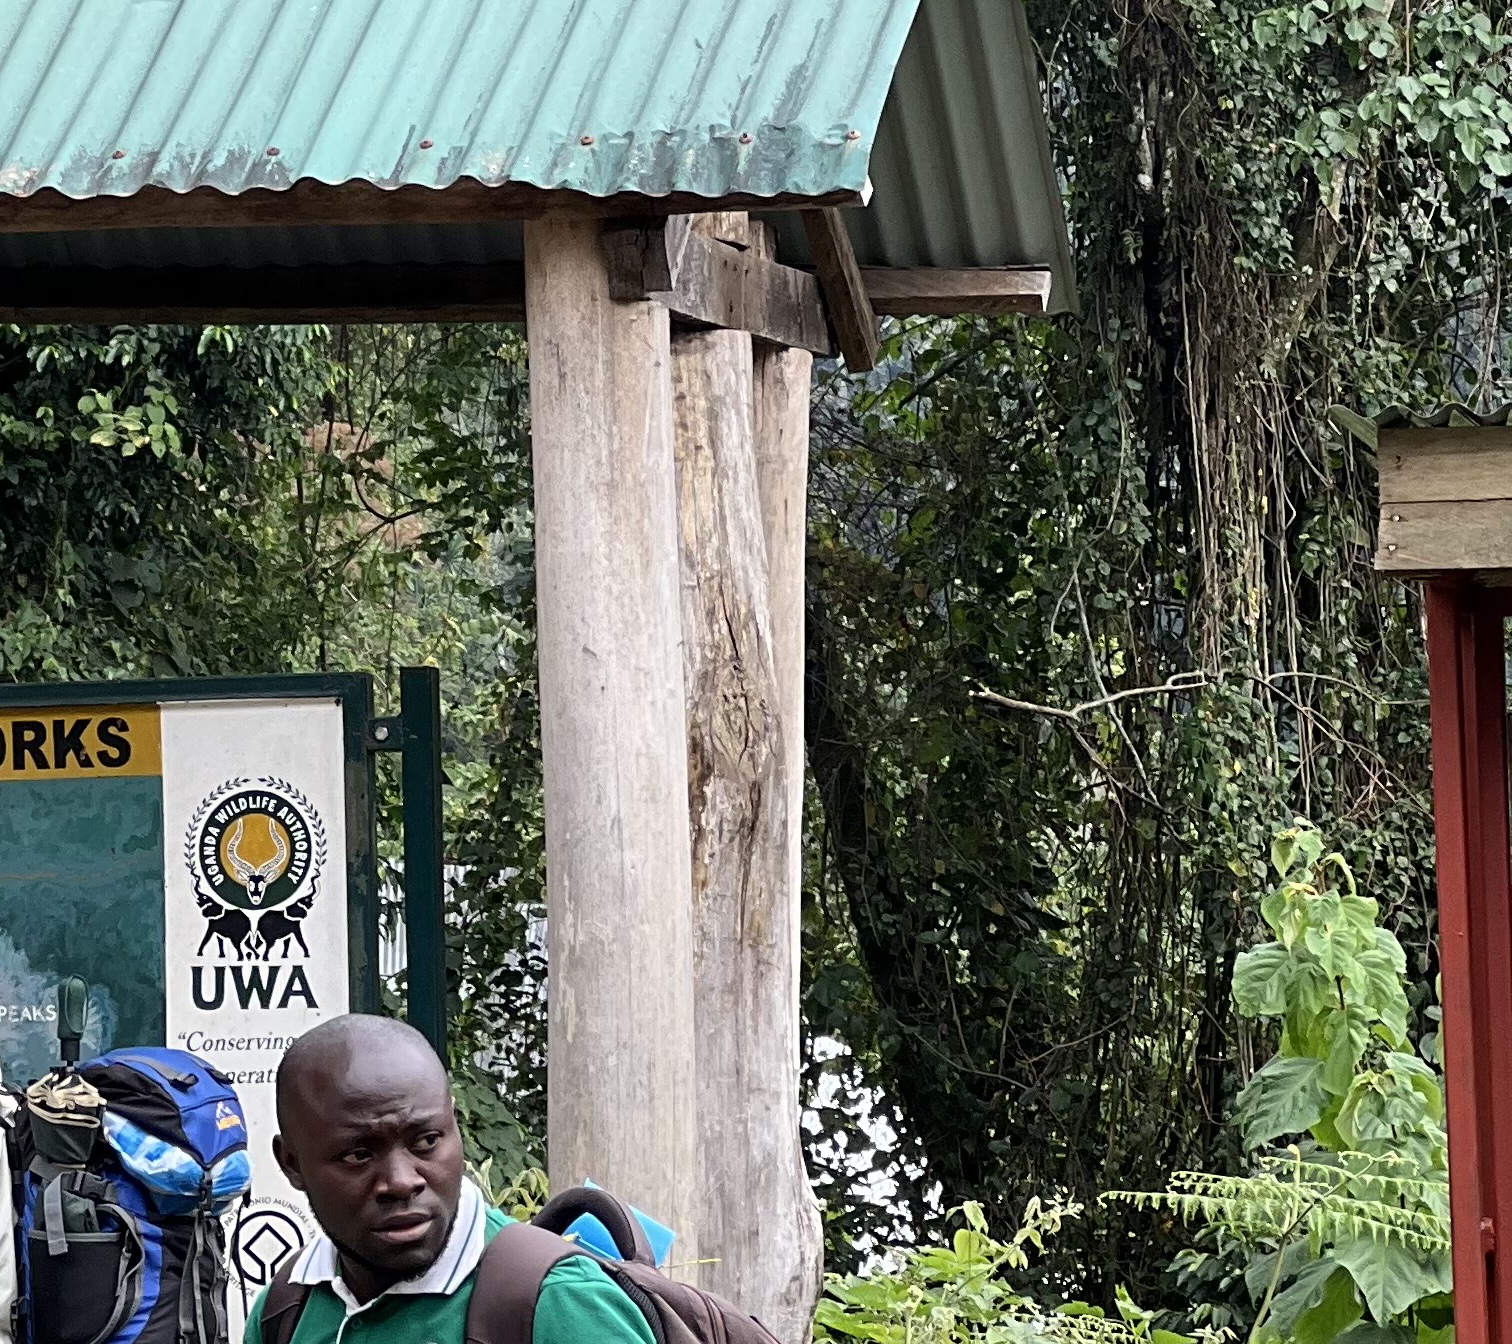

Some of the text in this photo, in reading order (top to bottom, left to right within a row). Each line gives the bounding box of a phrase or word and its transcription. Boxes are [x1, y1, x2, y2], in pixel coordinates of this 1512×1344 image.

[203, 796, 308, 886] UGANDA WILDLIFE AUTHORITY
[191, 964, 318, 1010] UWA
